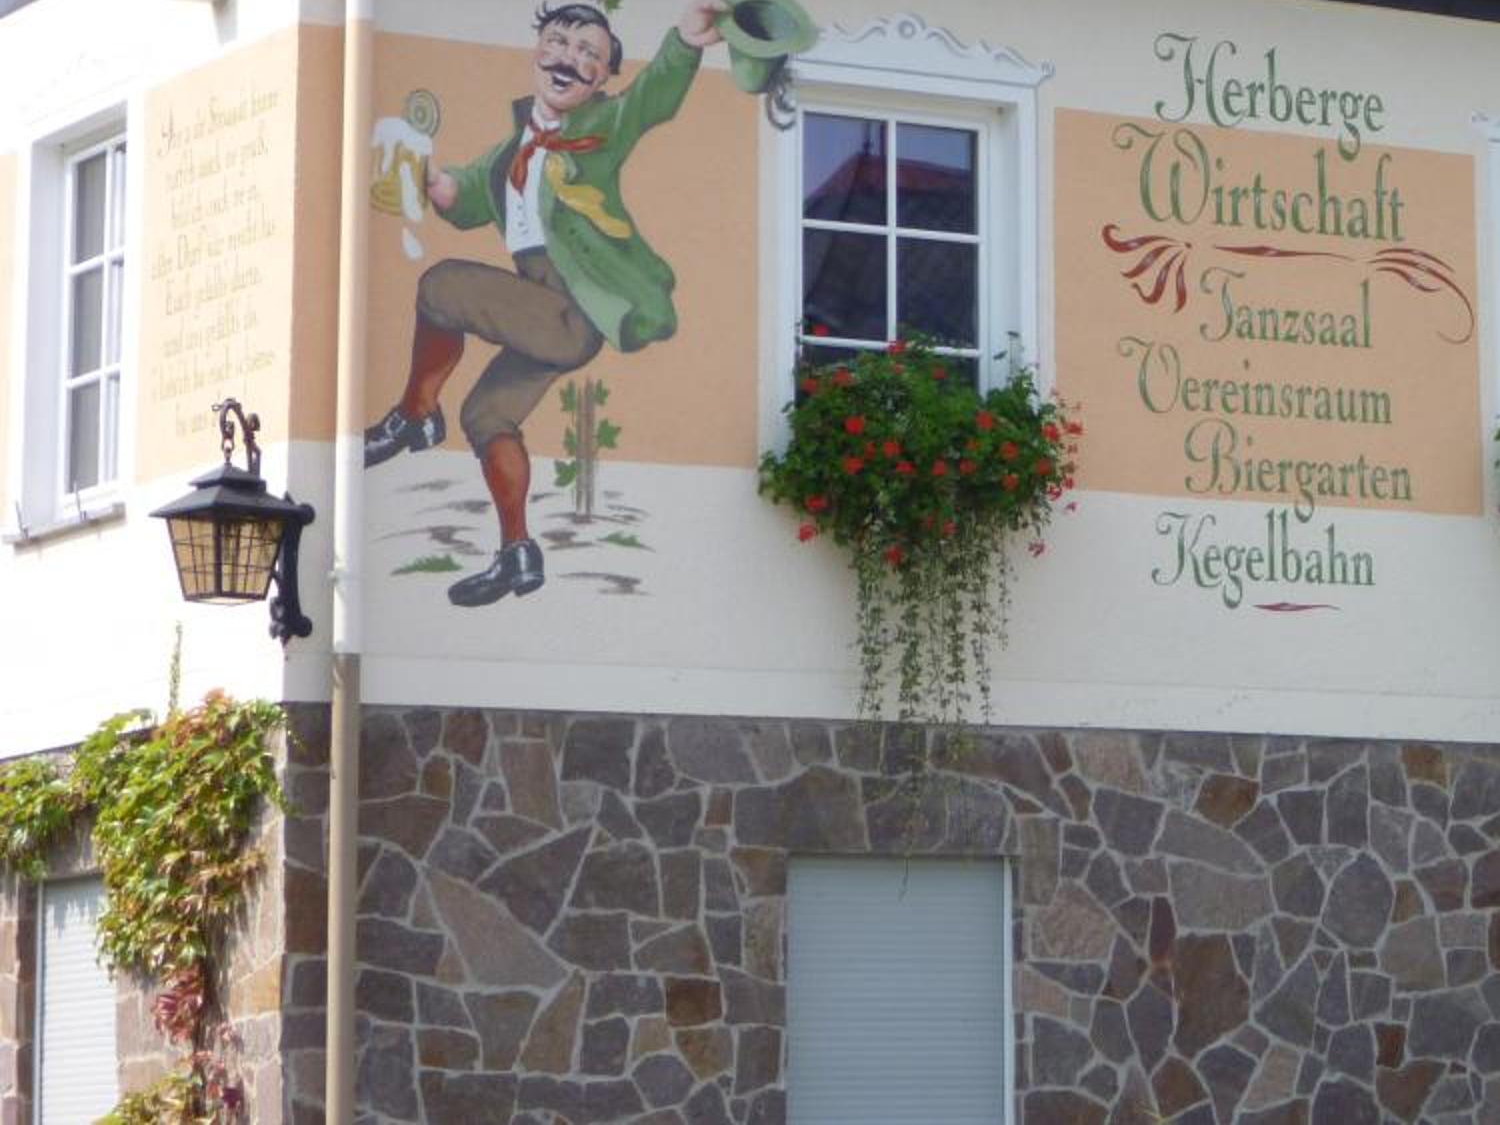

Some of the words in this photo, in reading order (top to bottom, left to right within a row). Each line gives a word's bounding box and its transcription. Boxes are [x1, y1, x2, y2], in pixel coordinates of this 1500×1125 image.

[1153, 32, 1385, 161] Herberge
[1112, 122, 1406, 242] Wirtschaft
[1200, 266, 1373, 349] Tanzsaal
[1119, 336, 1393, 425] Vereinsraum
[1184, 418, 1413, 523] Biergarten
[1152, 508, 1376, 609] Kegelbahn
